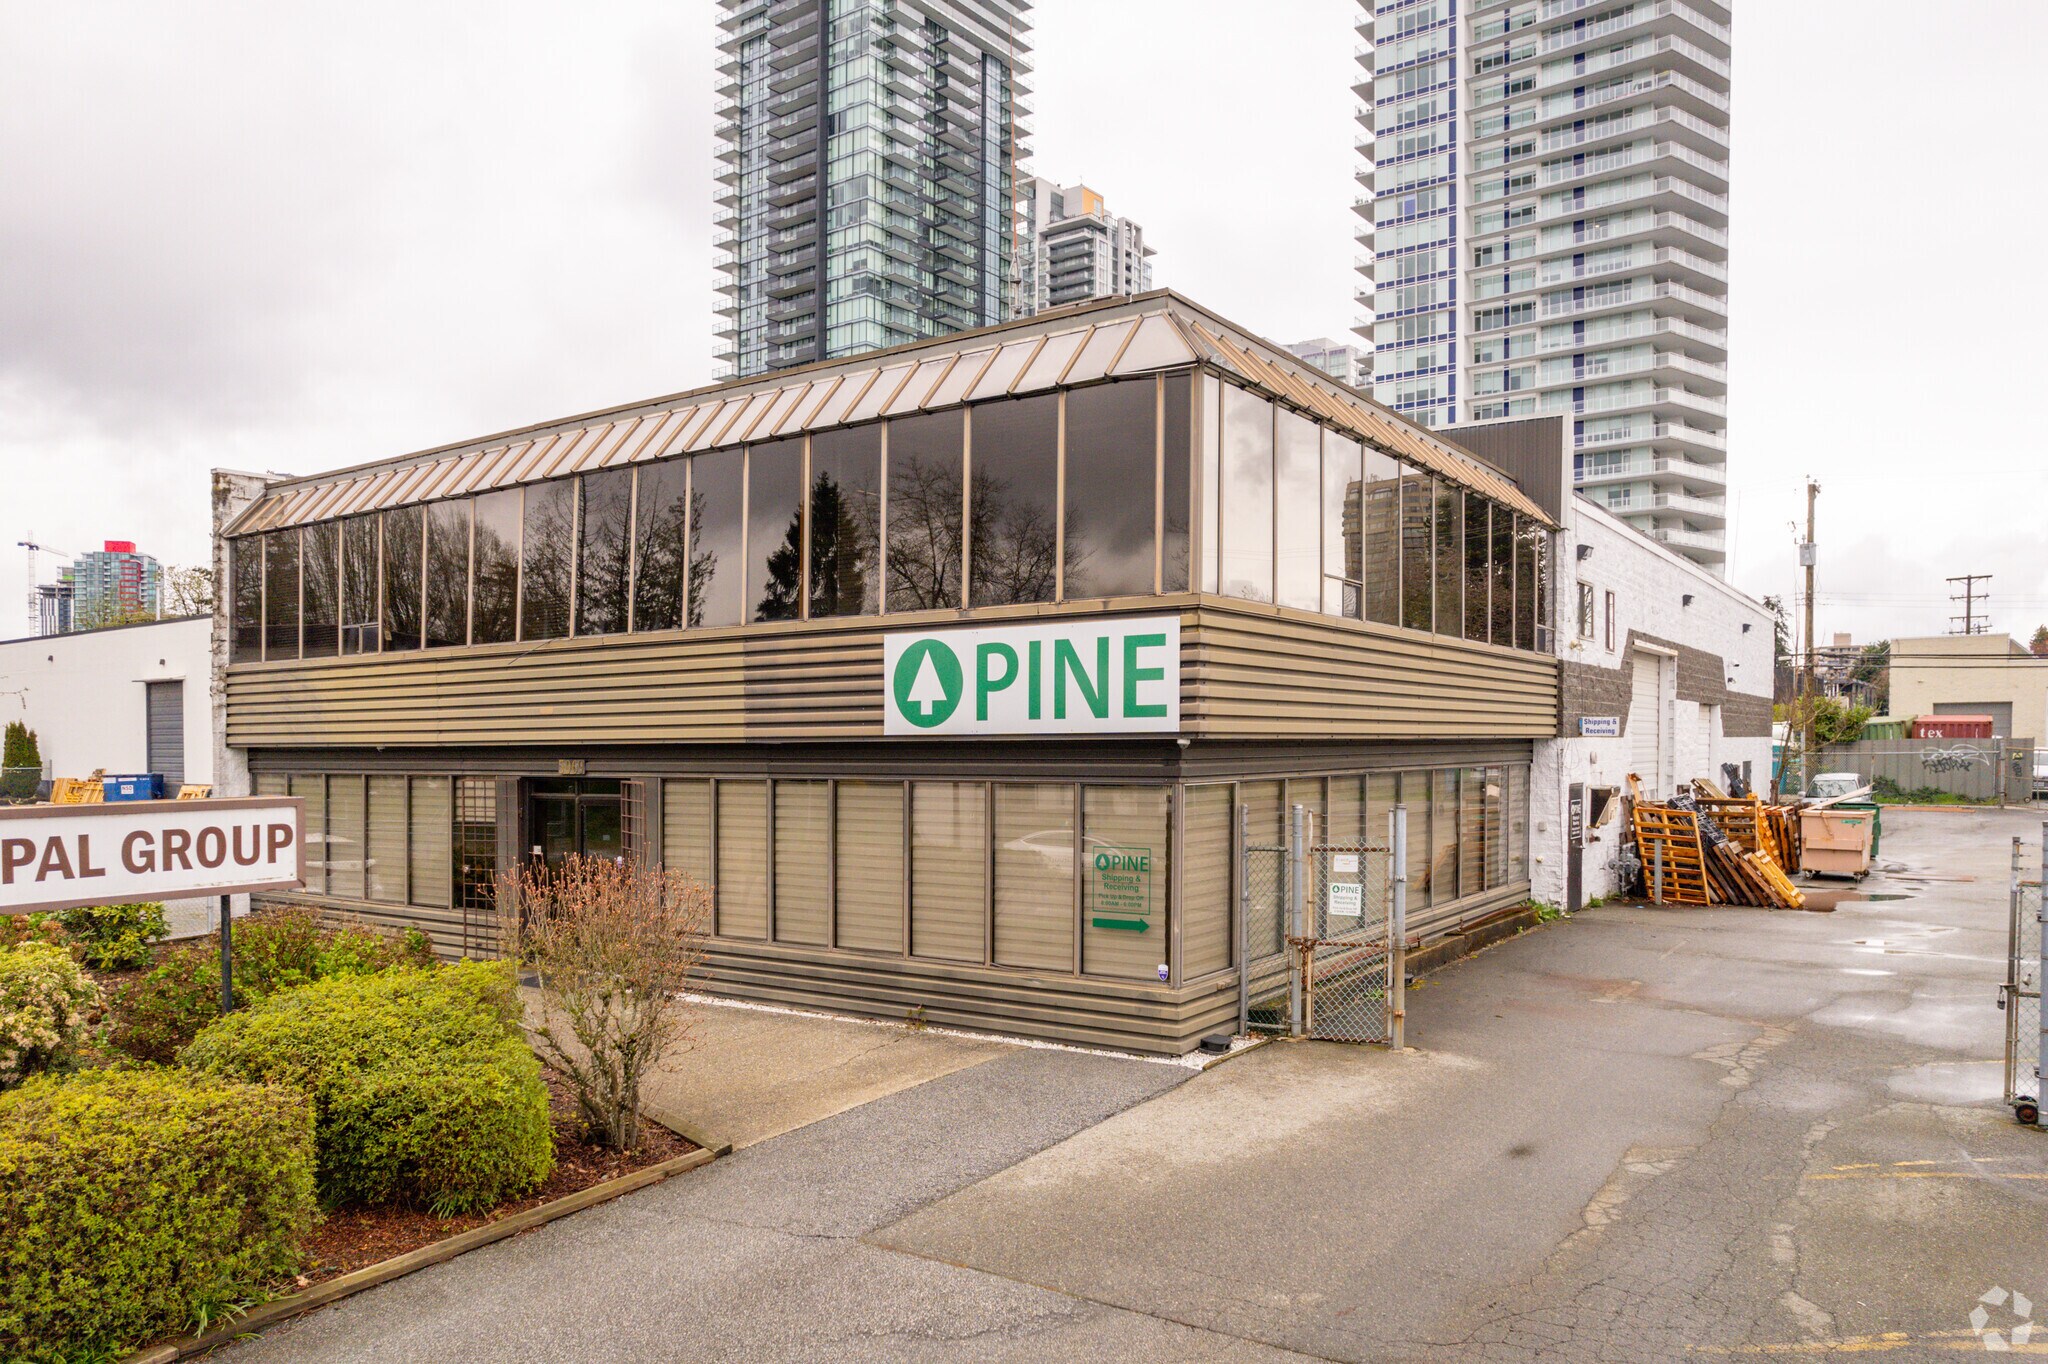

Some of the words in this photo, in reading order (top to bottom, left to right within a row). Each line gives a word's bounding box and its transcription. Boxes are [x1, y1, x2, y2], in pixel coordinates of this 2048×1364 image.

[976, 633, 1168, 721] PINE
[1920, 727, 1943, 738] tex
[2, 834, 106, 884] PAL
[121, 823, 294, 874] GROUP
[1112, 856, 1148, 872] PINE
[1102, 874, 1133, 883] Shipping
[1104, 882, 1139, 893] Receiving
